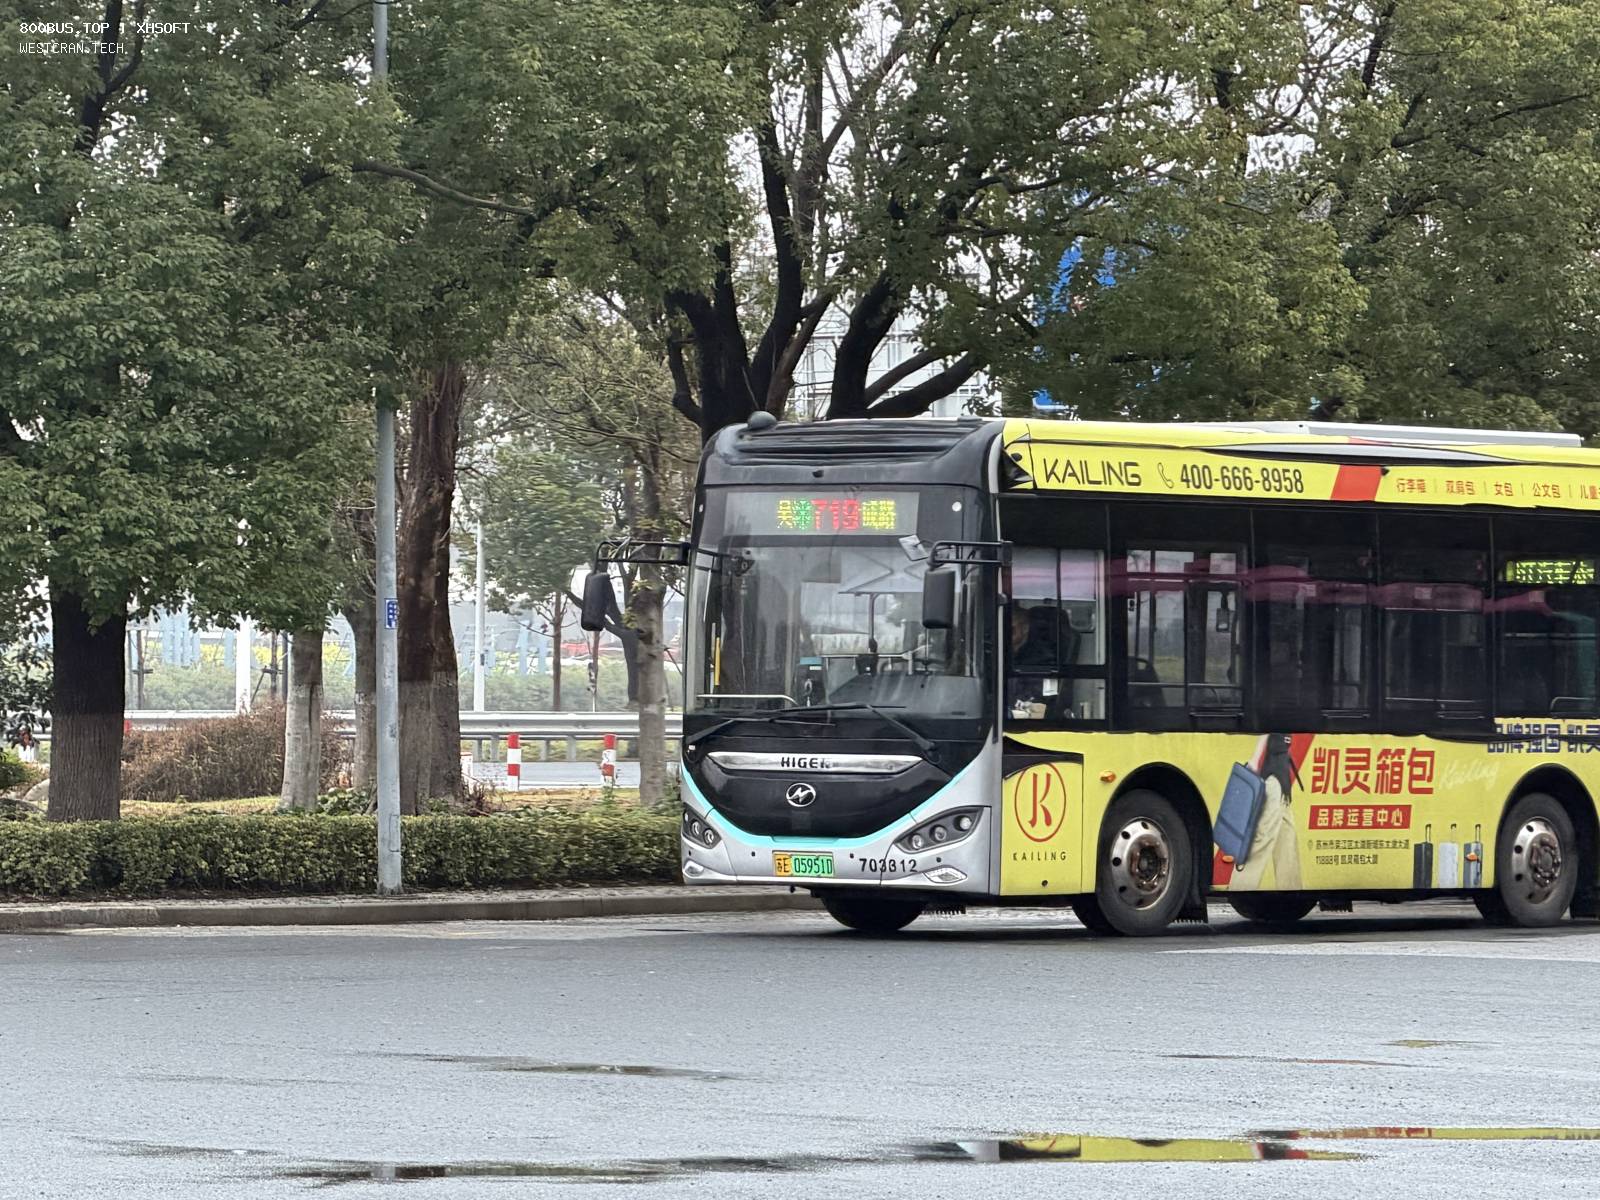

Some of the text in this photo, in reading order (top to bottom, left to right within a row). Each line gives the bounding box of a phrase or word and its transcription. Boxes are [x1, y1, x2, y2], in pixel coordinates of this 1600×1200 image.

[1043, 457, 1142, 487] KAILING
[1179, 463, 1304, 494] 400-666-8958
[1445, 479, 1476, 496] 双肩包
[1493, 481, 1514, 497] 女包
[1531, 482, 1562, 499] 公文包
[1580, 484, 1600, 500] 儿童
[1311, 747, 1435, 795] 凯灵箱包
[1317, 807, 1403, 827] 品牌运营中心
[1013, 851, 1067, 861] KAILING
